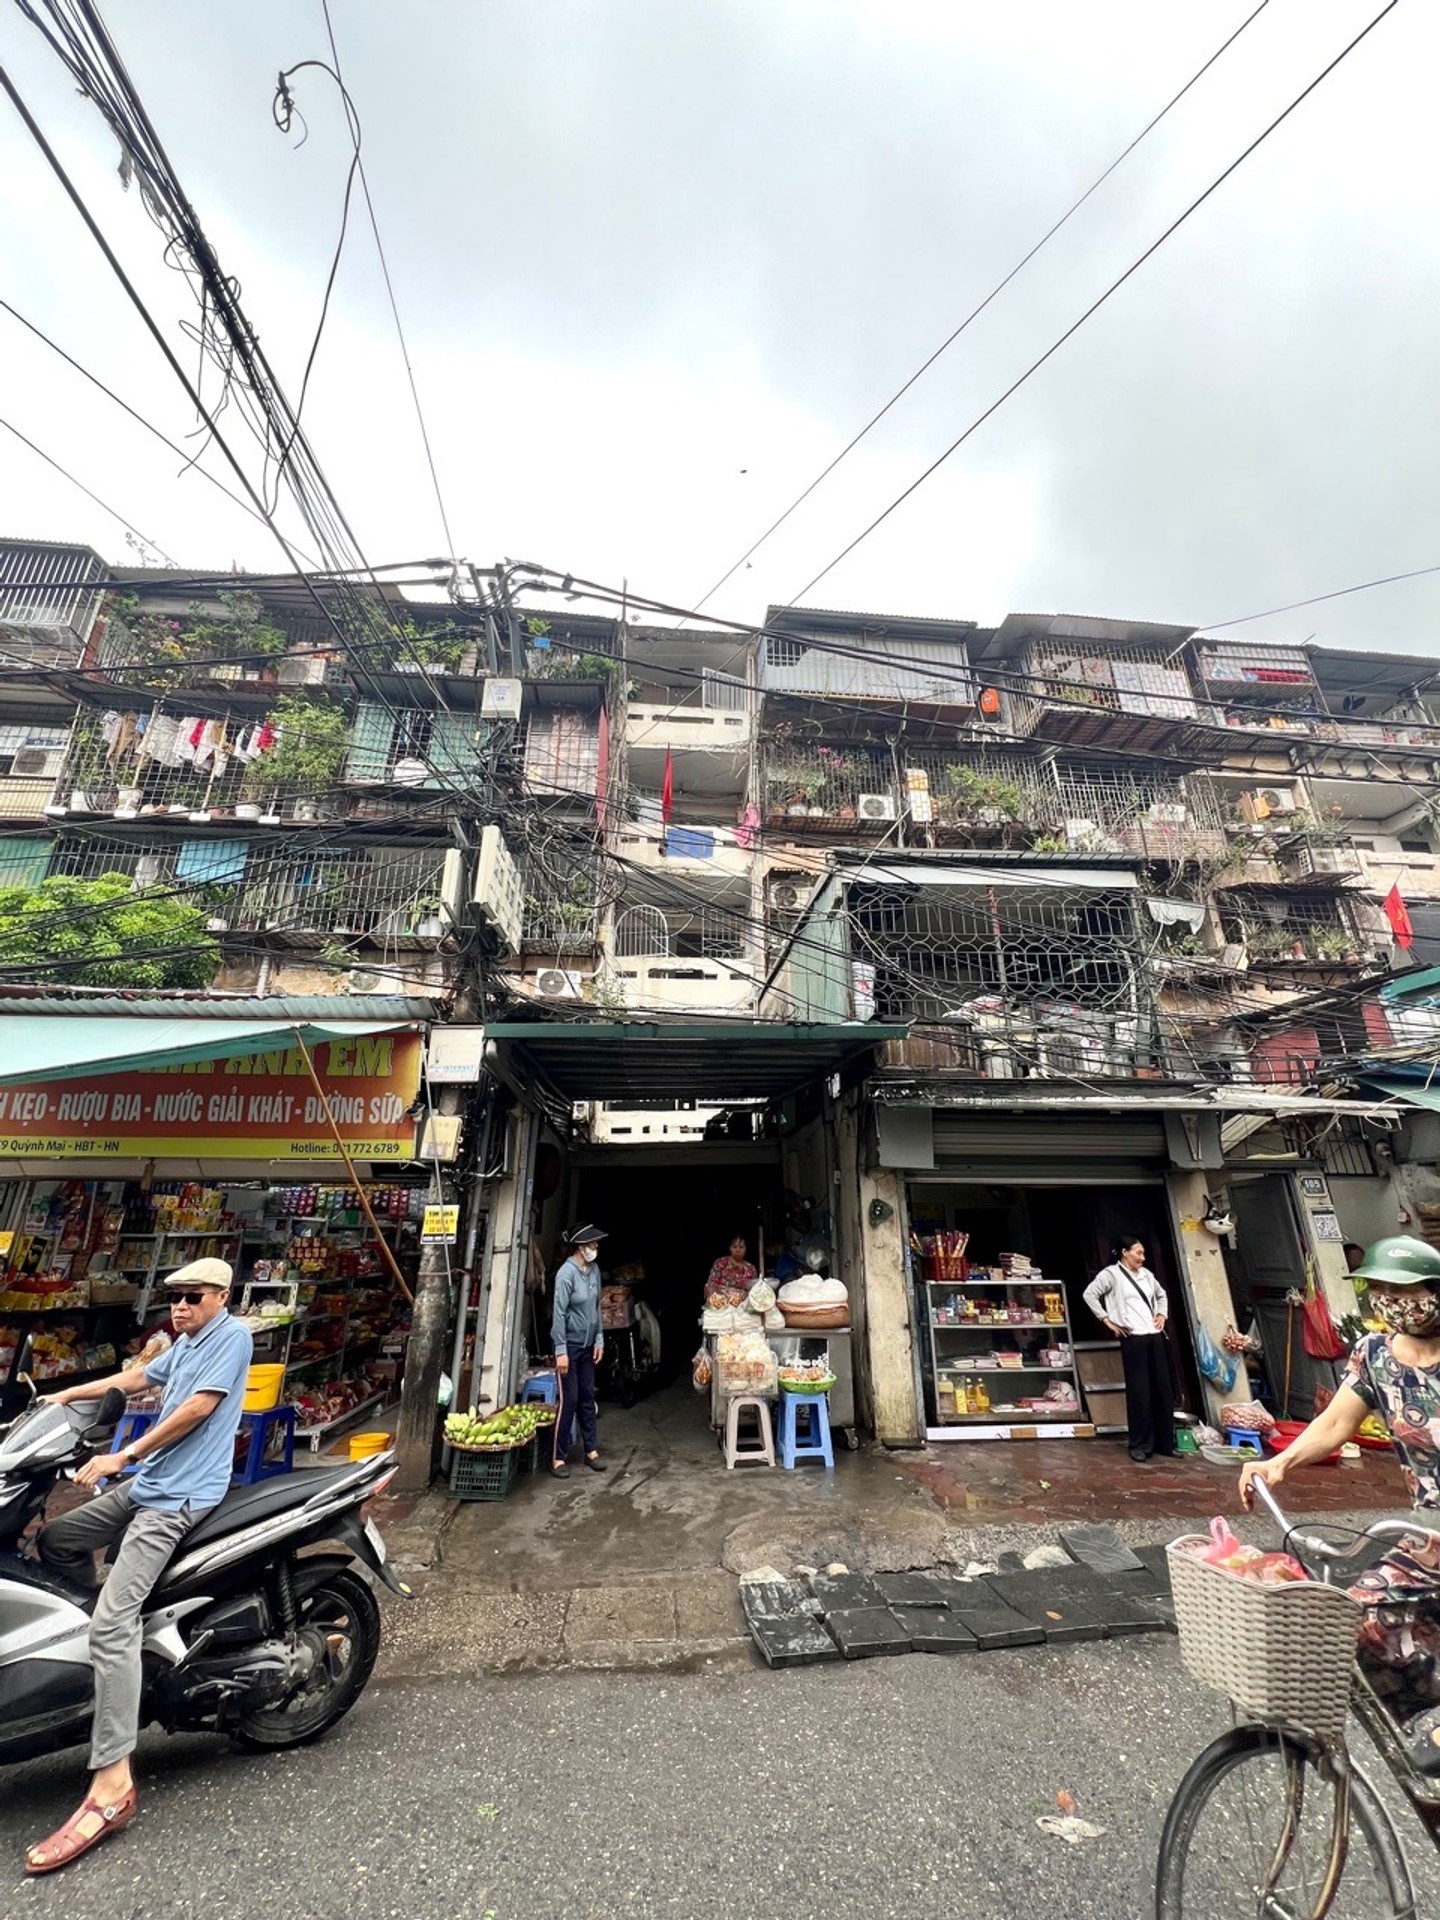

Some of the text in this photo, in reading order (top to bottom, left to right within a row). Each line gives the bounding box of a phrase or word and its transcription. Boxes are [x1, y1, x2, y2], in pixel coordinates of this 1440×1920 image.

[326, 1037, 394, 1077] EM
[9, 1092, 48, 1126] KẸO
[57, 1091, 109, 1127] RƯỢU
[110, 1094, 141, 1121] BIA
[153, 1089, 204, 1122] NƯỚC
[207, 1086, 244, 1122] GIẢI
[247, 1090, 295, 1124] KHÁT
[304, 1090, 365, 1125] ĐƯỜNG
[369, 1092, 405, 1125] SỮA
[47, 1140, 66, 1151] Mai
[74, 1141, 96, 1152] HBT
[104, 1142, 120, 1152] HN
[290, 1143, 330, 1153] Hotline:
[373, 1144, 400, 1153] 6789
